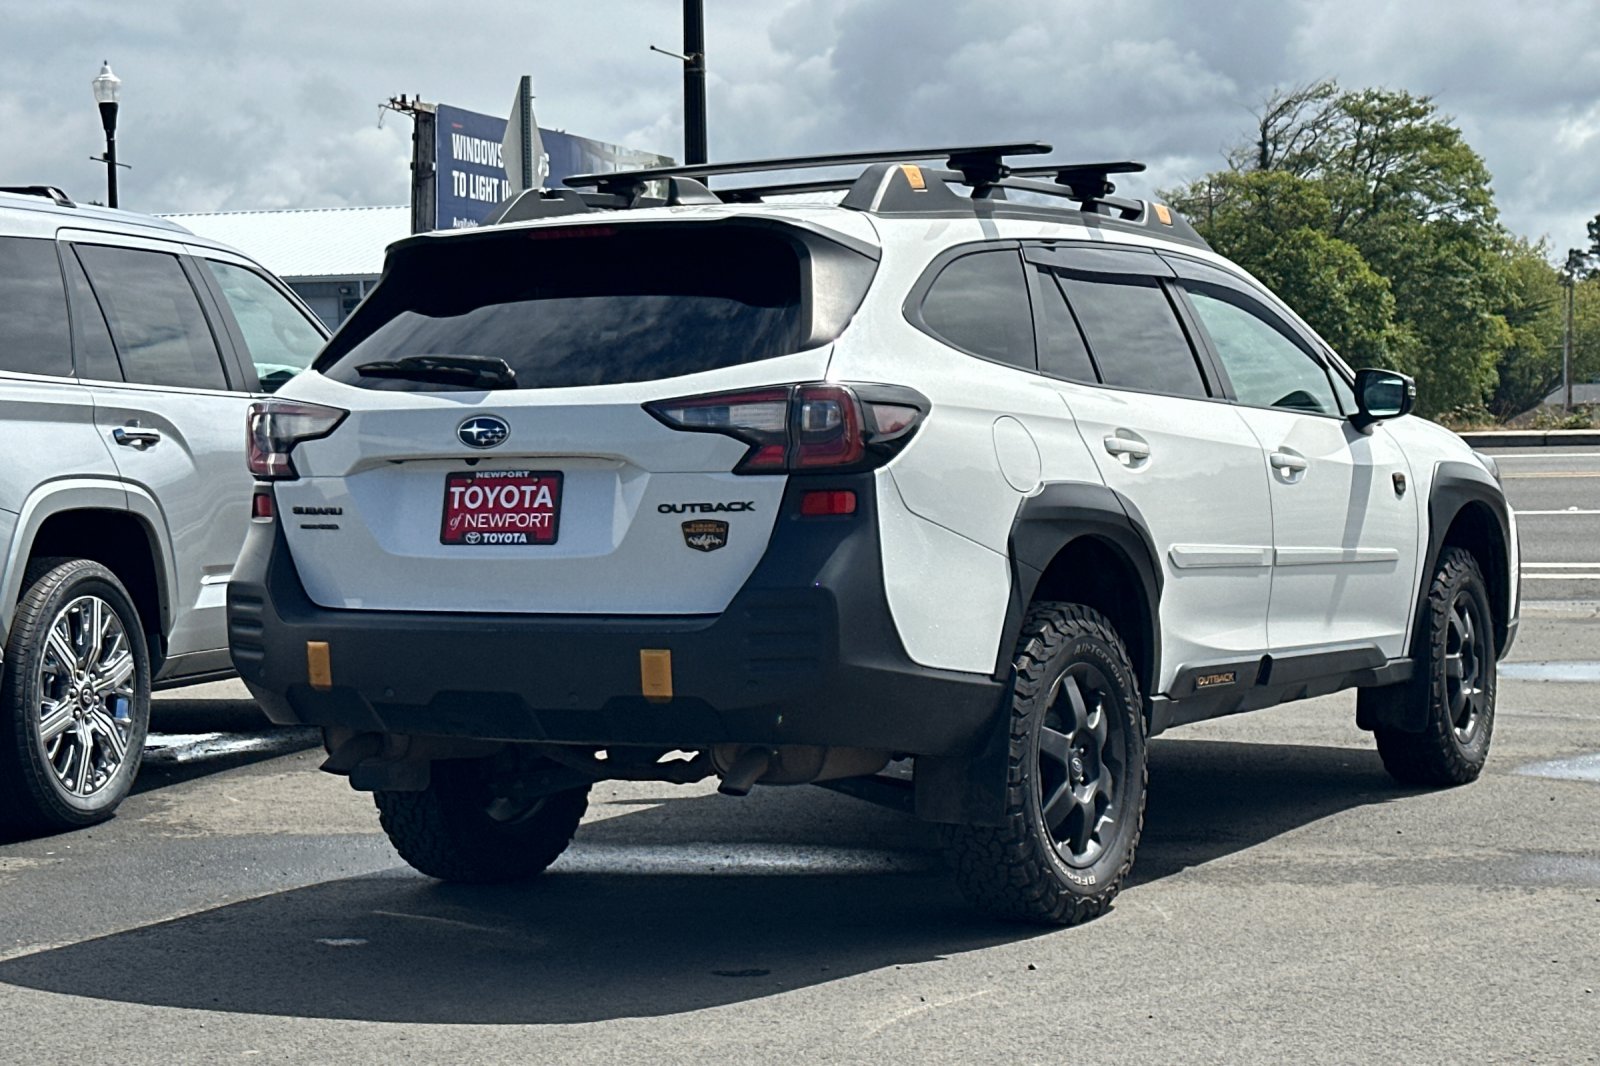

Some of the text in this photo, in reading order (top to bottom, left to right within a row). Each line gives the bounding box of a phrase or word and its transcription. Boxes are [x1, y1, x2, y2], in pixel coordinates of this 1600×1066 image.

[452, 170, 467, 198] TO
[469, 173, 499, 203] LIGHT
[475, 470, 530, 479] NEWPORT
[450, 485, 553, 510] TOYOTA
[657, 501, 756, 514] OUTBACK
[450, 512, 554, 531] of NEWPORT
[482, 532, 528, 544] TOYOTA
[1198, 672, 1235, 685] OUTBACK
